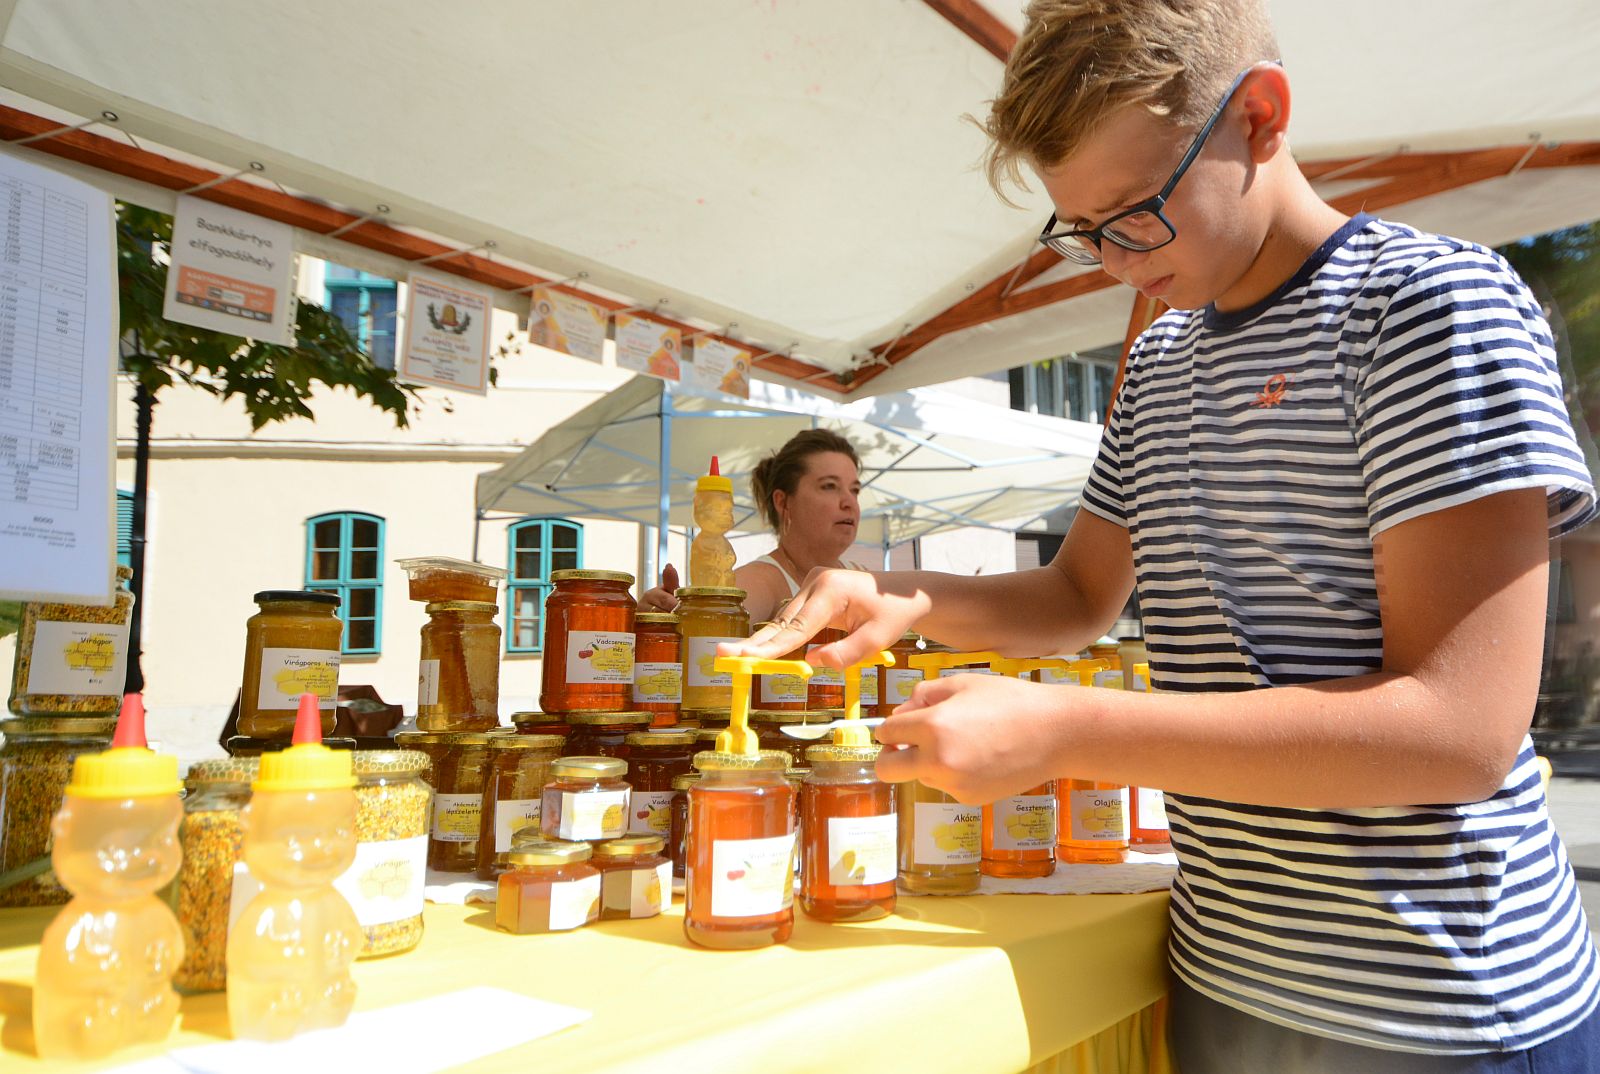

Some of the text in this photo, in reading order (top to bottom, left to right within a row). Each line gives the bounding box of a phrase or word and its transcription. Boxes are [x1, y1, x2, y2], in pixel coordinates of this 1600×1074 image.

[196, 216, 273, 248] Bankkártya
[189, 238, 275, 271] elfogadóhely
[80, 636, 112, 646] Virágpor
[284, 659, 322, 668] Virágporos
